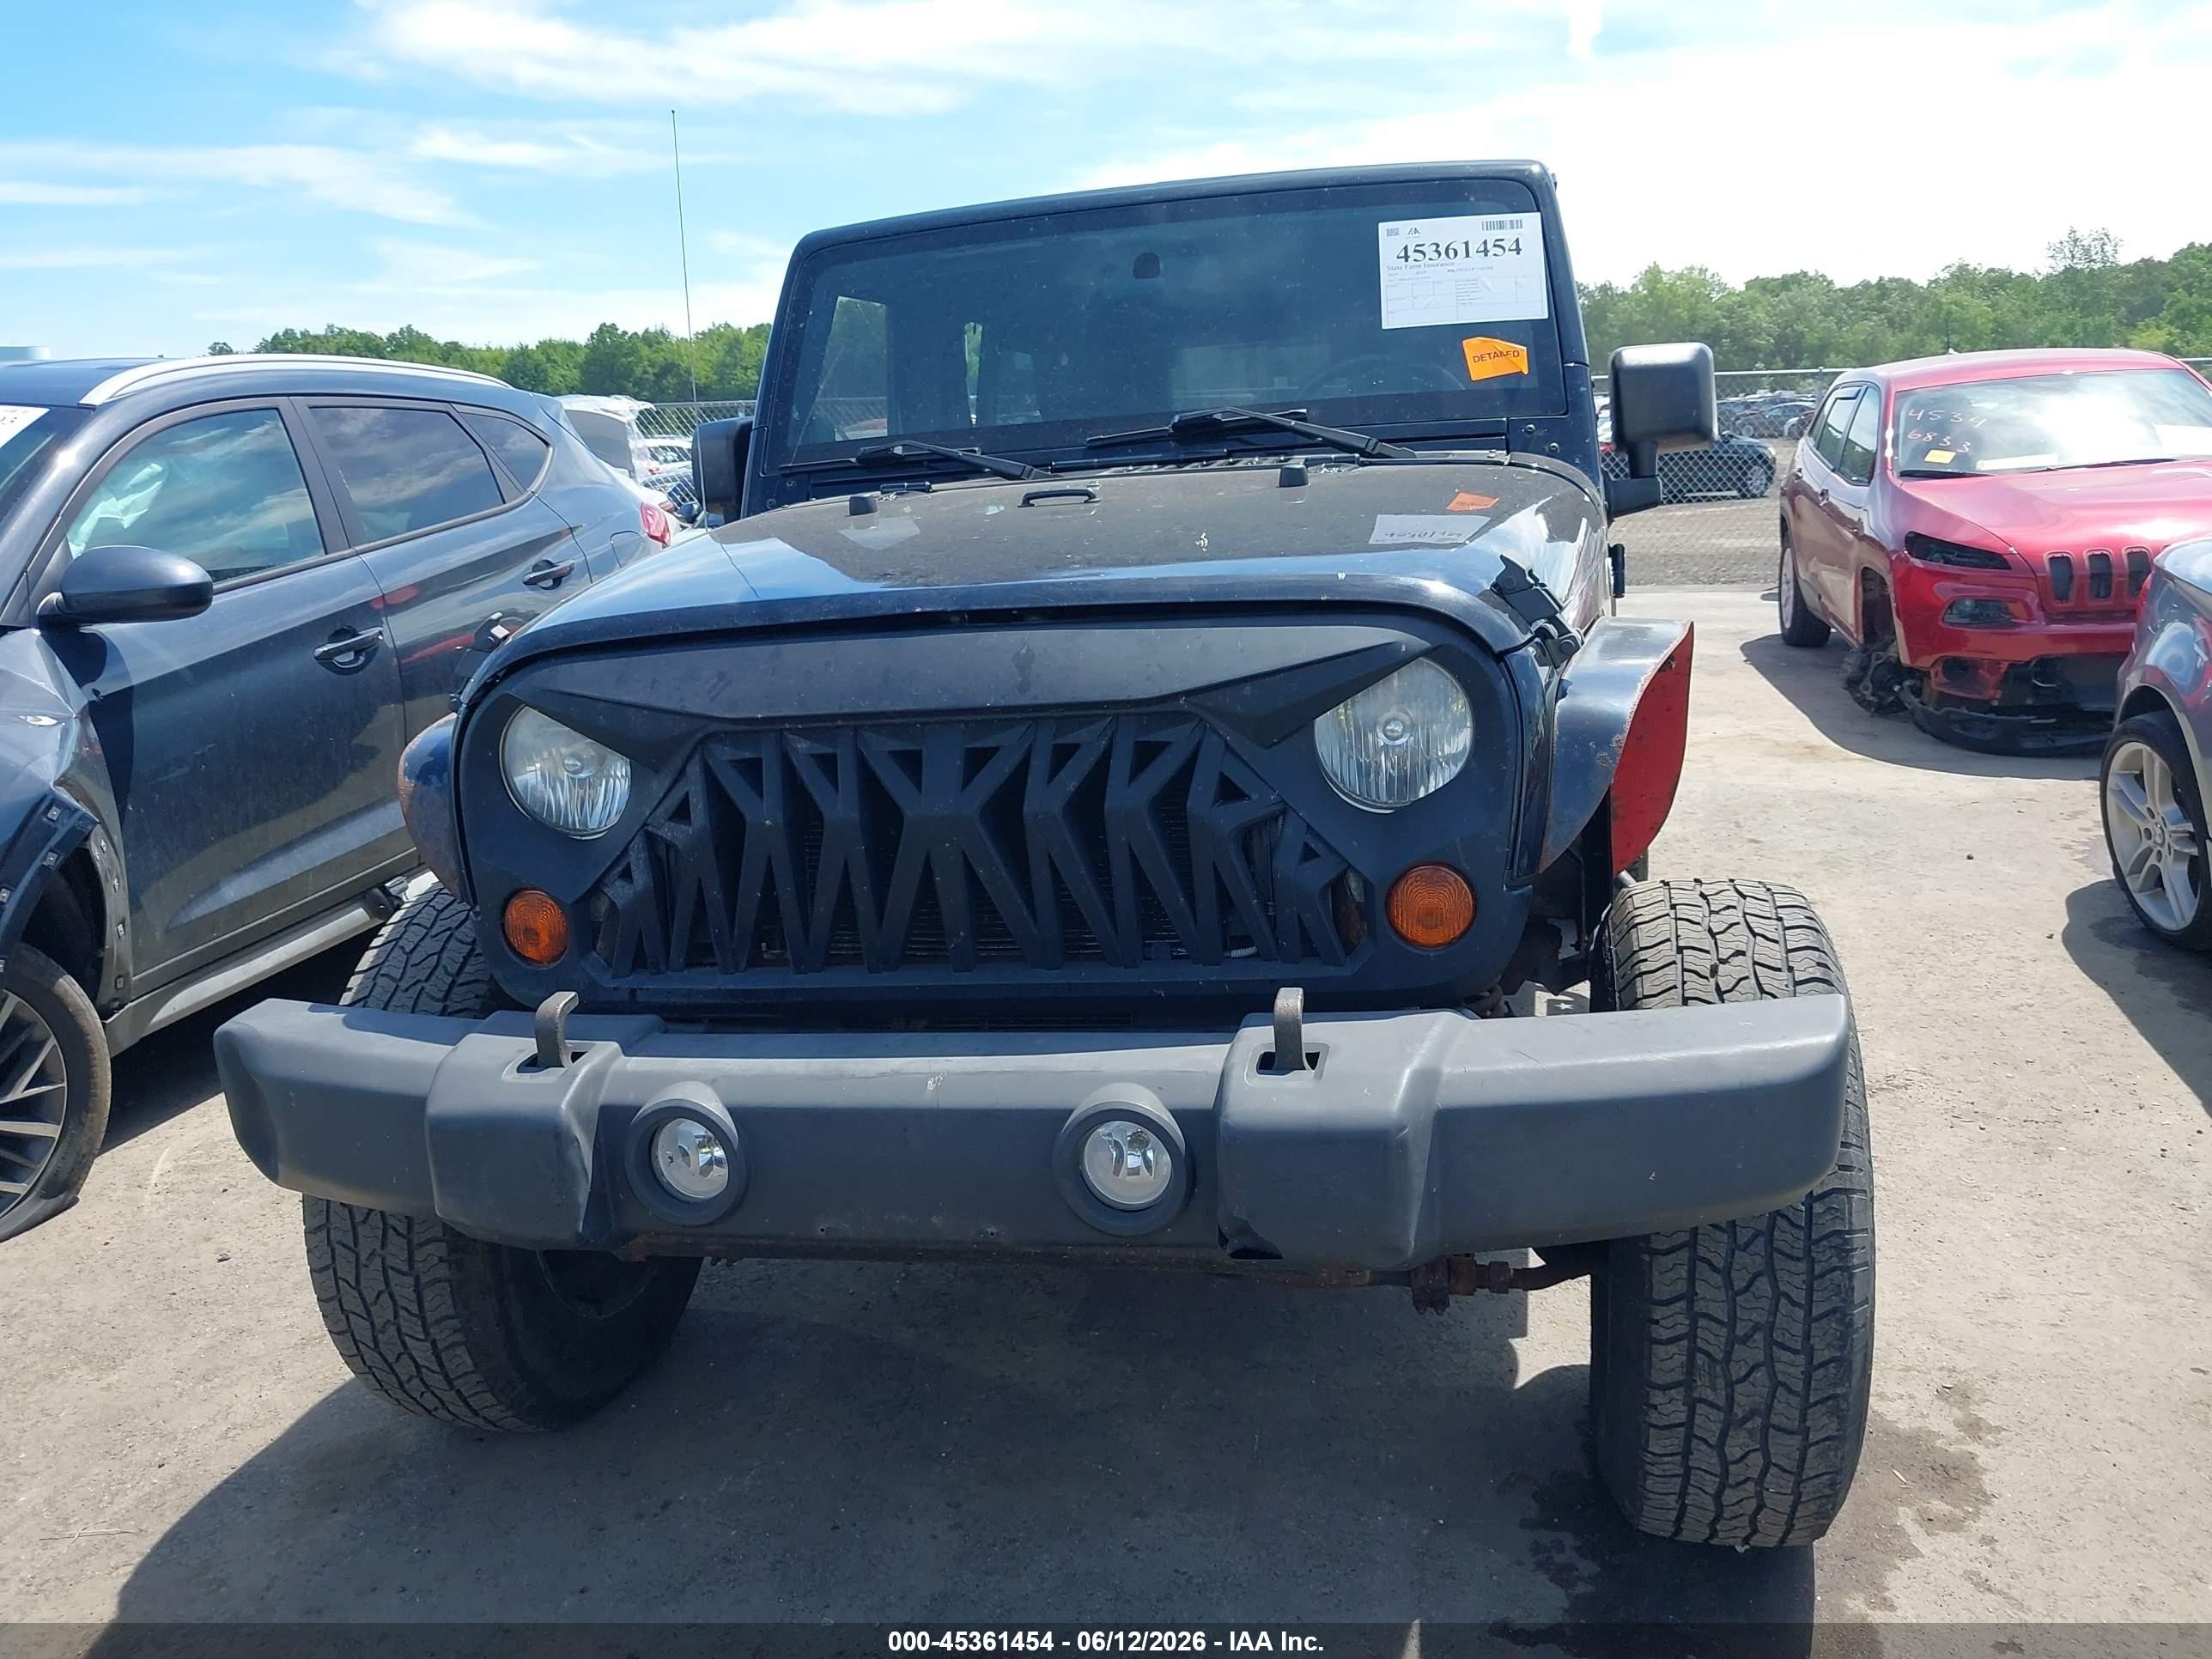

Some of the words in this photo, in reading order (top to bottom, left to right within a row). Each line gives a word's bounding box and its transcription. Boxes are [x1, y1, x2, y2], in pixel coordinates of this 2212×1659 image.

[1396, 237, 1522, 263] 45361454
[1908, 409, 1987, 428] 4534
[1908, 430, 1972, 453] 6833
